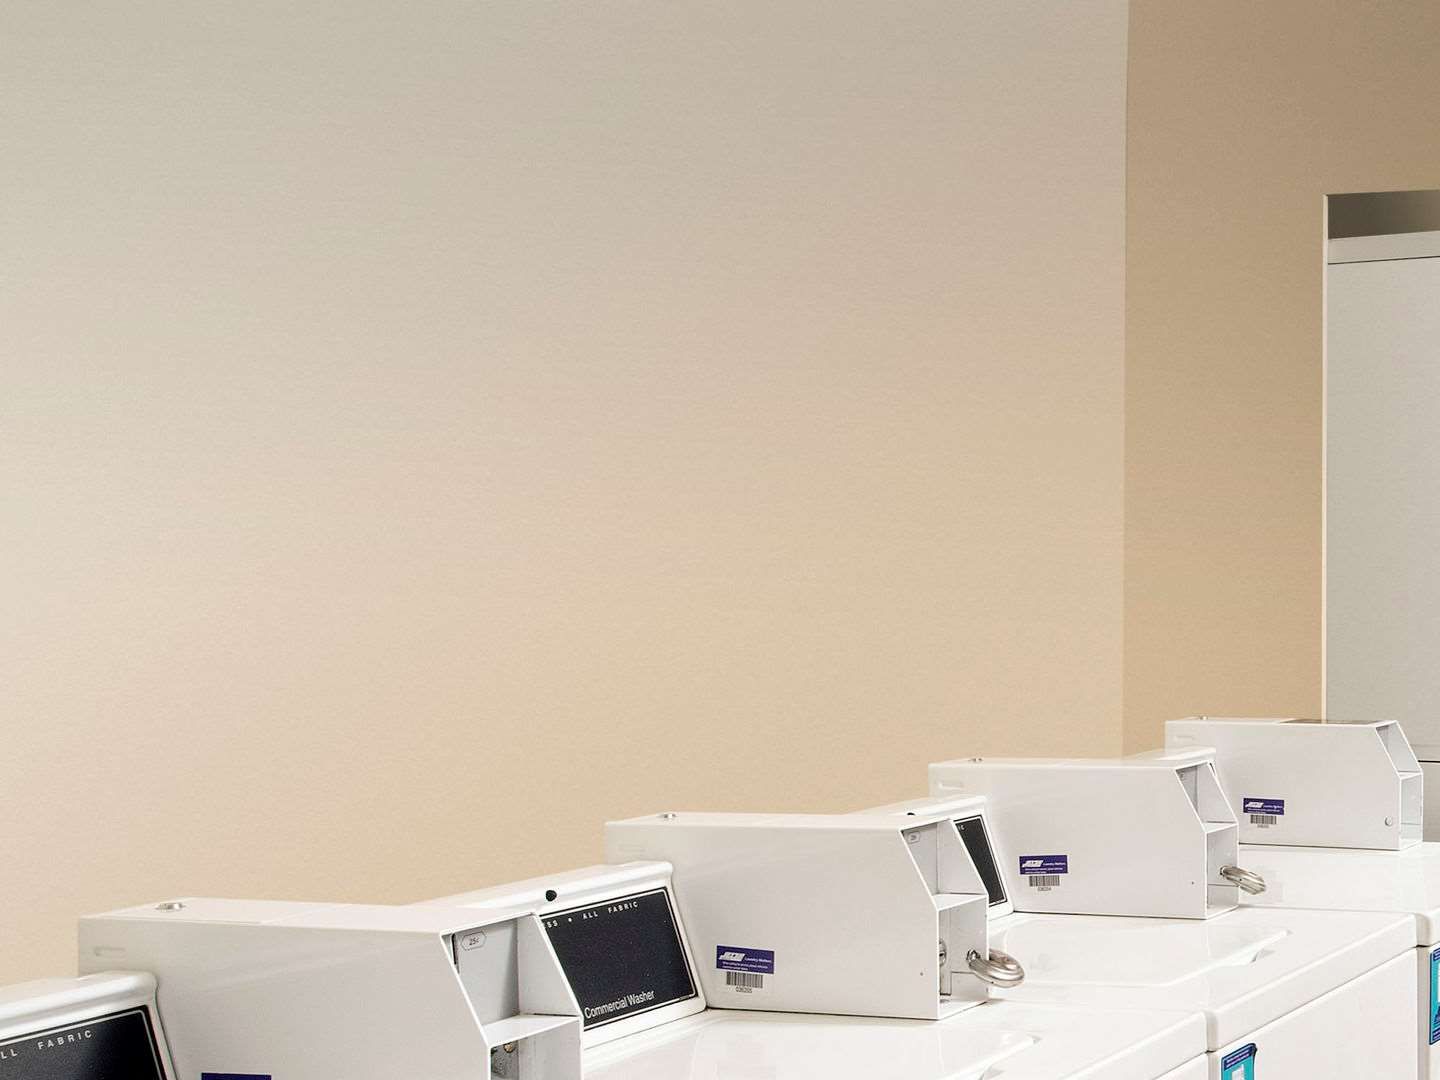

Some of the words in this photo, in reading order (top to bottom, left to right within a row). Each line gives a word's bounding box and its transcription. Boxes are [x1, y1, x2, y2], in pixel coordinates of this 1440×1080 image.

[582, 910, 599, 920] ALL
[607, 901, 639, 915] FABRIC
[584, 996, 629, 1019] Commercial
[627, 990, 656, 1006] Washer
[37, 1030, 92, 1050] FABRIC
